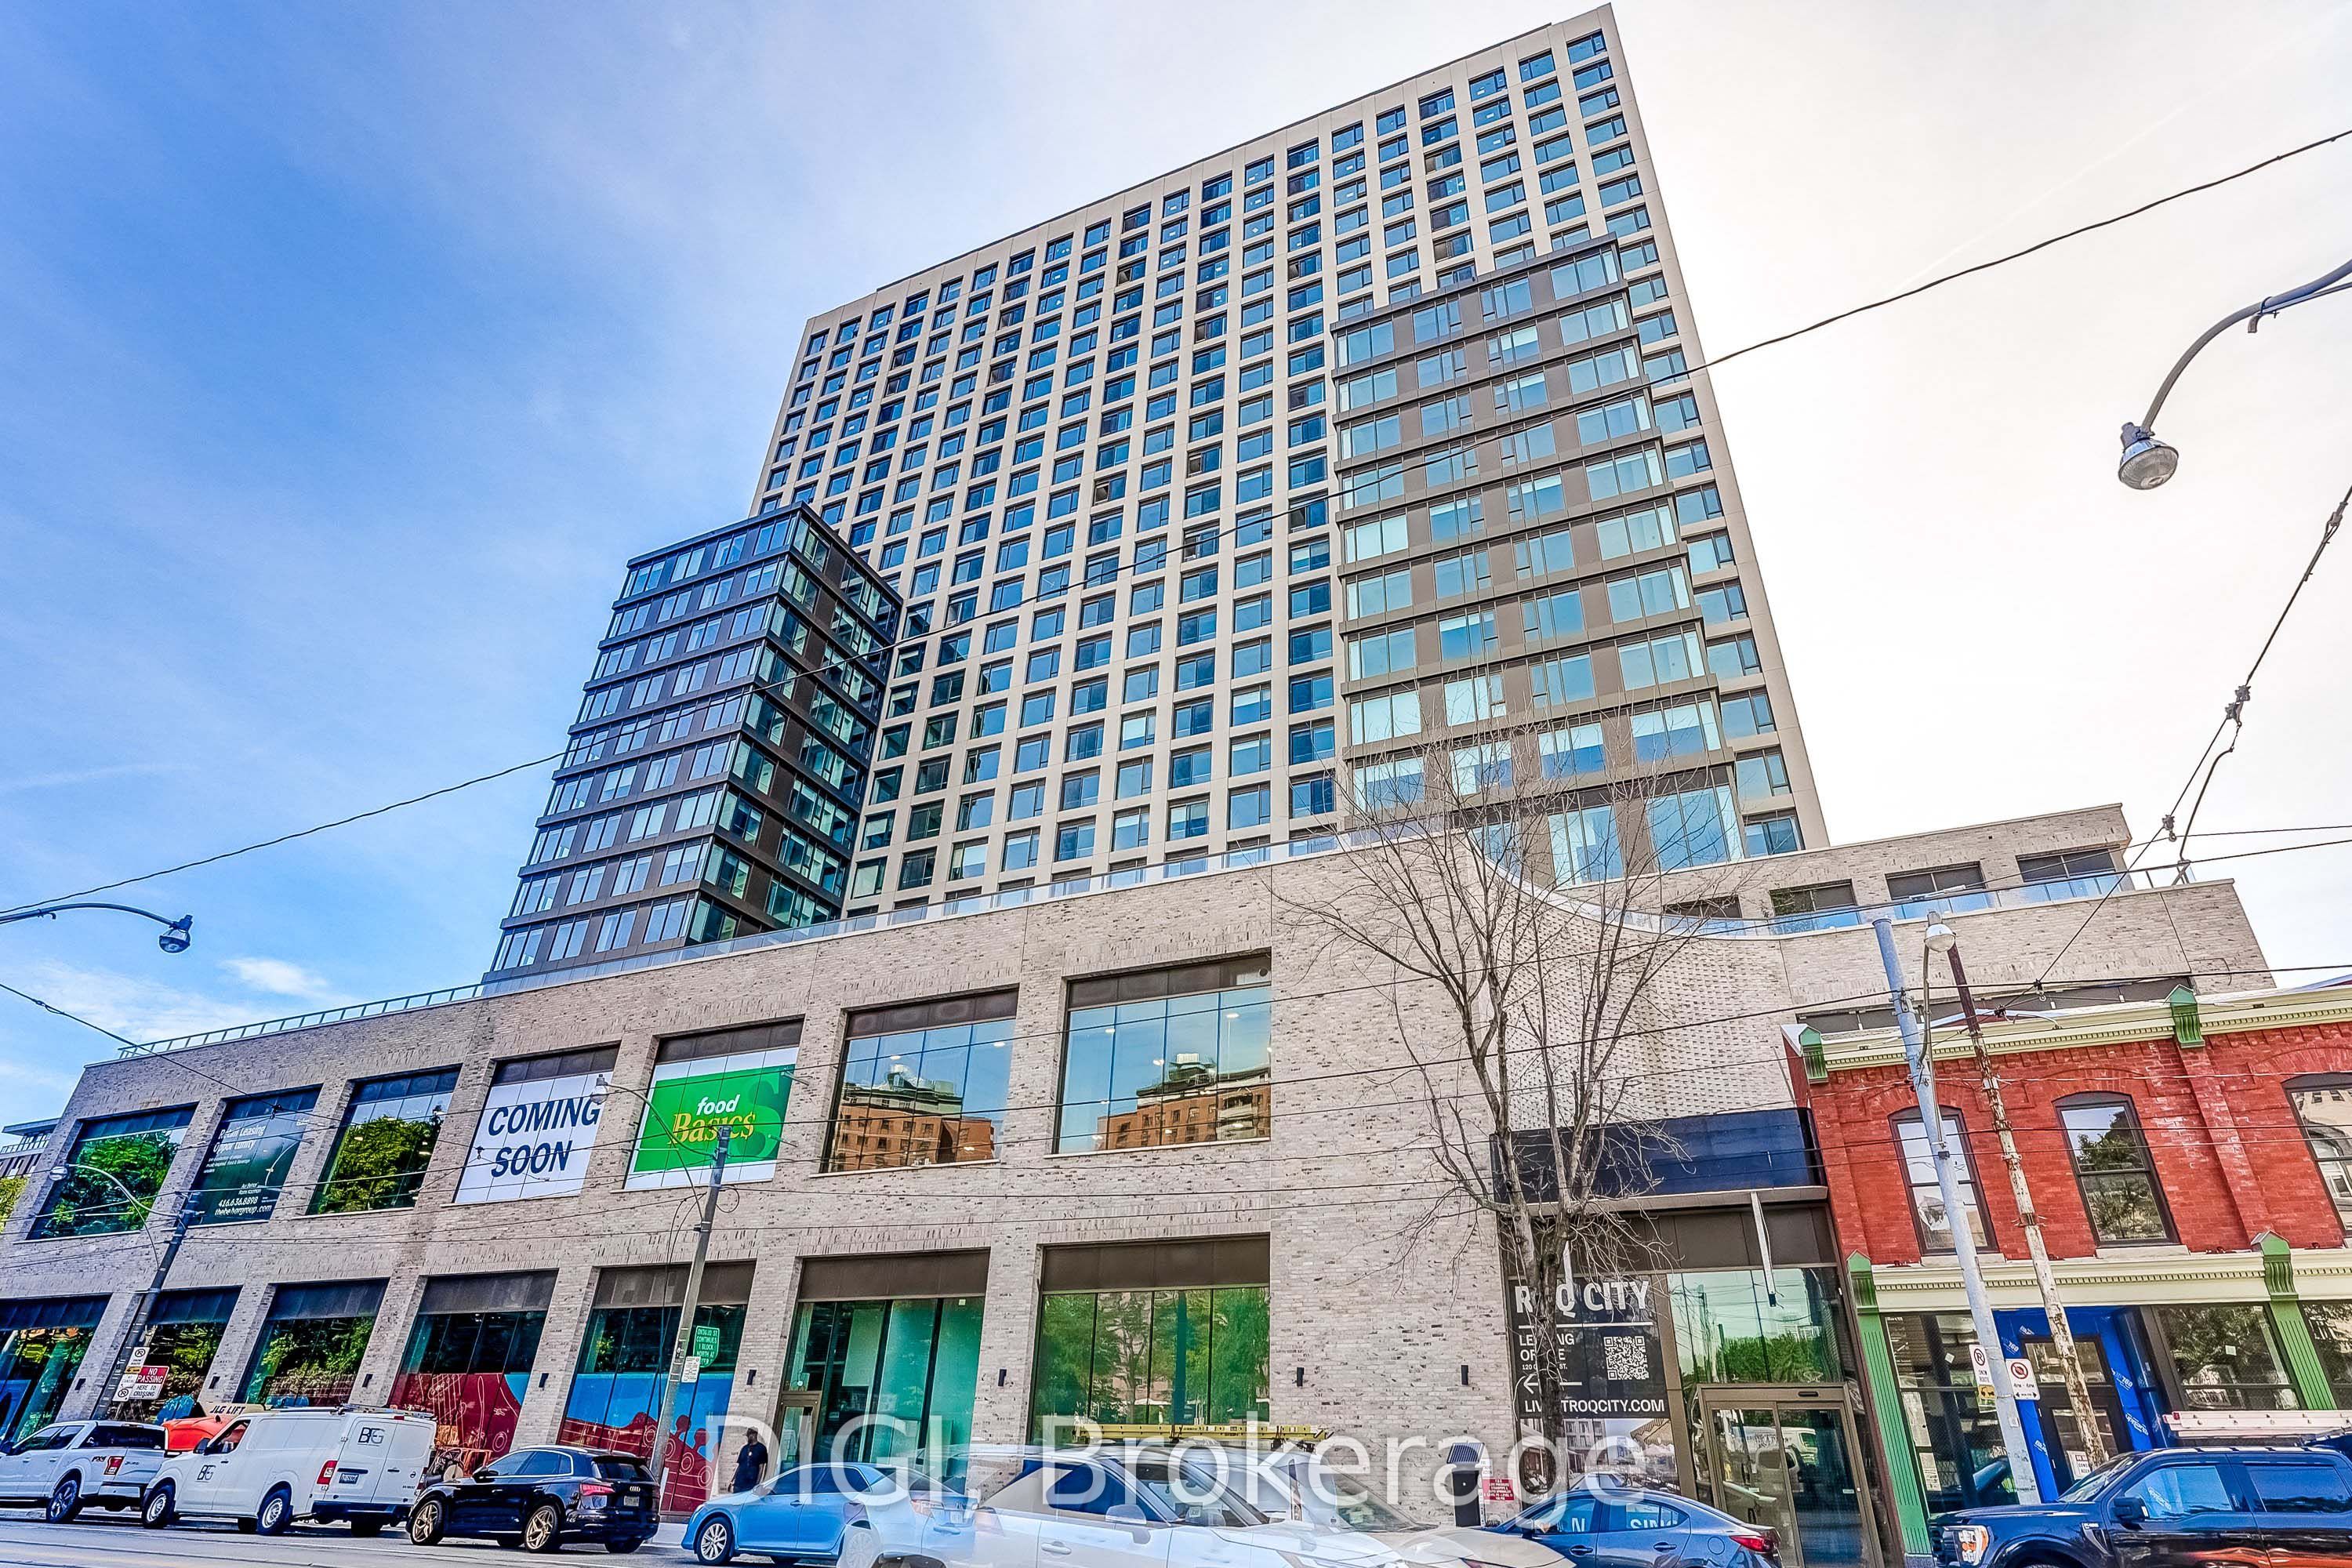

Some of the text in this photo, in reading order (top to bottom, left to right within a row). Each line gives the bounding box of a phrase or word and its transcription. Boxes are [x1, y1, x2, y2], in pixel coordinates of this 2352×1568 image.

[695, 1094, 740, 1116] food
[488, 1097, 601, 1136] COMING
[239, 1124, 267, 1137] Leasing
[491, 1140, 573, 1178] SOON
[1515, 1280, 1650, 1318] RQ CITY
[1519, 1333, 1575, 1346] LENG
[1520, 1348, 1566, 1361] OFE
[209, 1405, 246, 1414] JLG LIFT
[1524, 1399, 1665, 1414] LIVTROQCITY.COM
